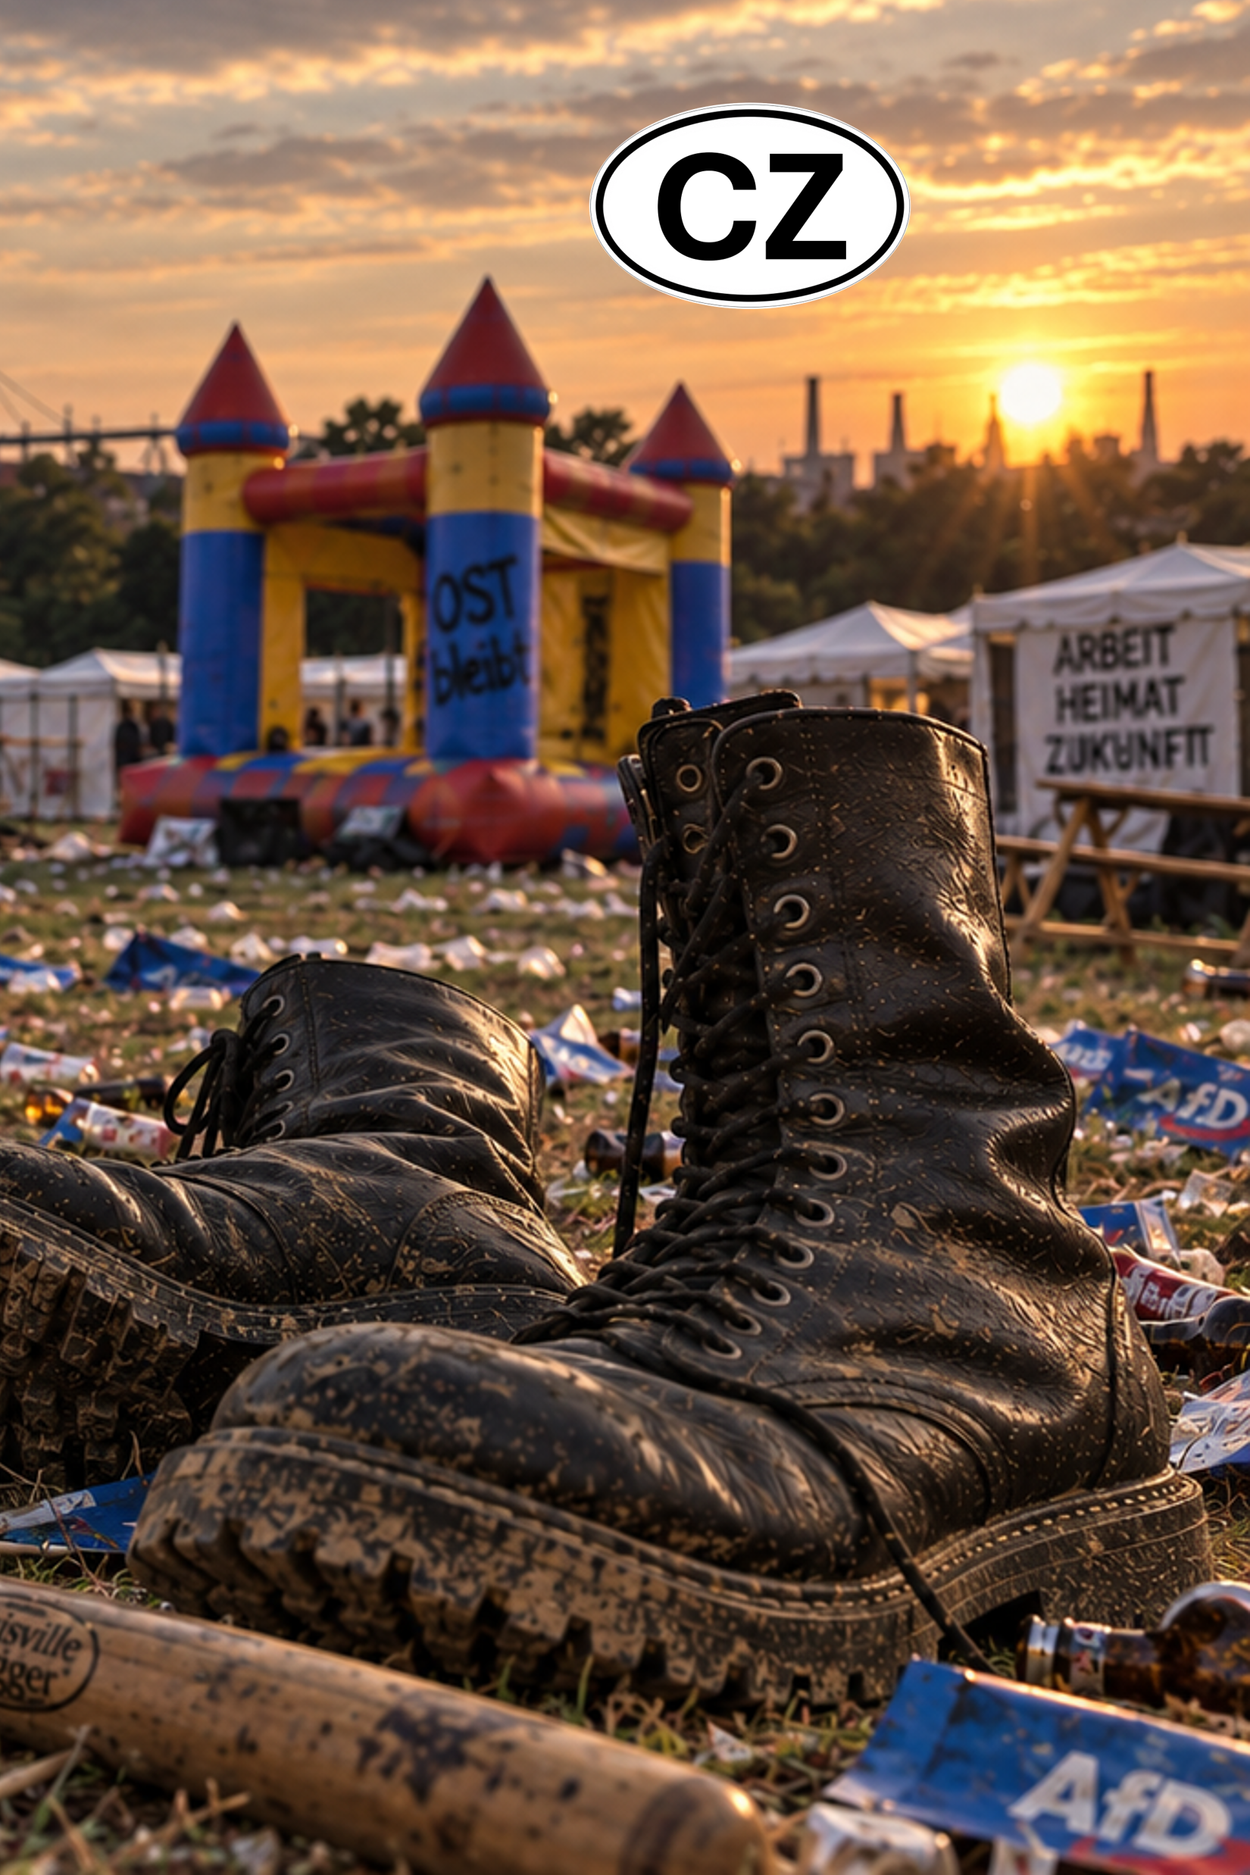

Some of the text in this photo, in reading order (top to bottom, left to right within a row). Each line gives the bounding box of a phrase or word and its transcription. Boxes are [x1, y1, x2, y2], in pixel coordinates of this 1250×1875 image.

[433, 554, 519, 634] OST
[1053, 623, 1176, 677] ARBEIT
[1055, 676, 1185, 725] HEIMAT
[1136, 1077, 1249, 1130] AfD
[1007, 1749, 1233, 1858] AfD
